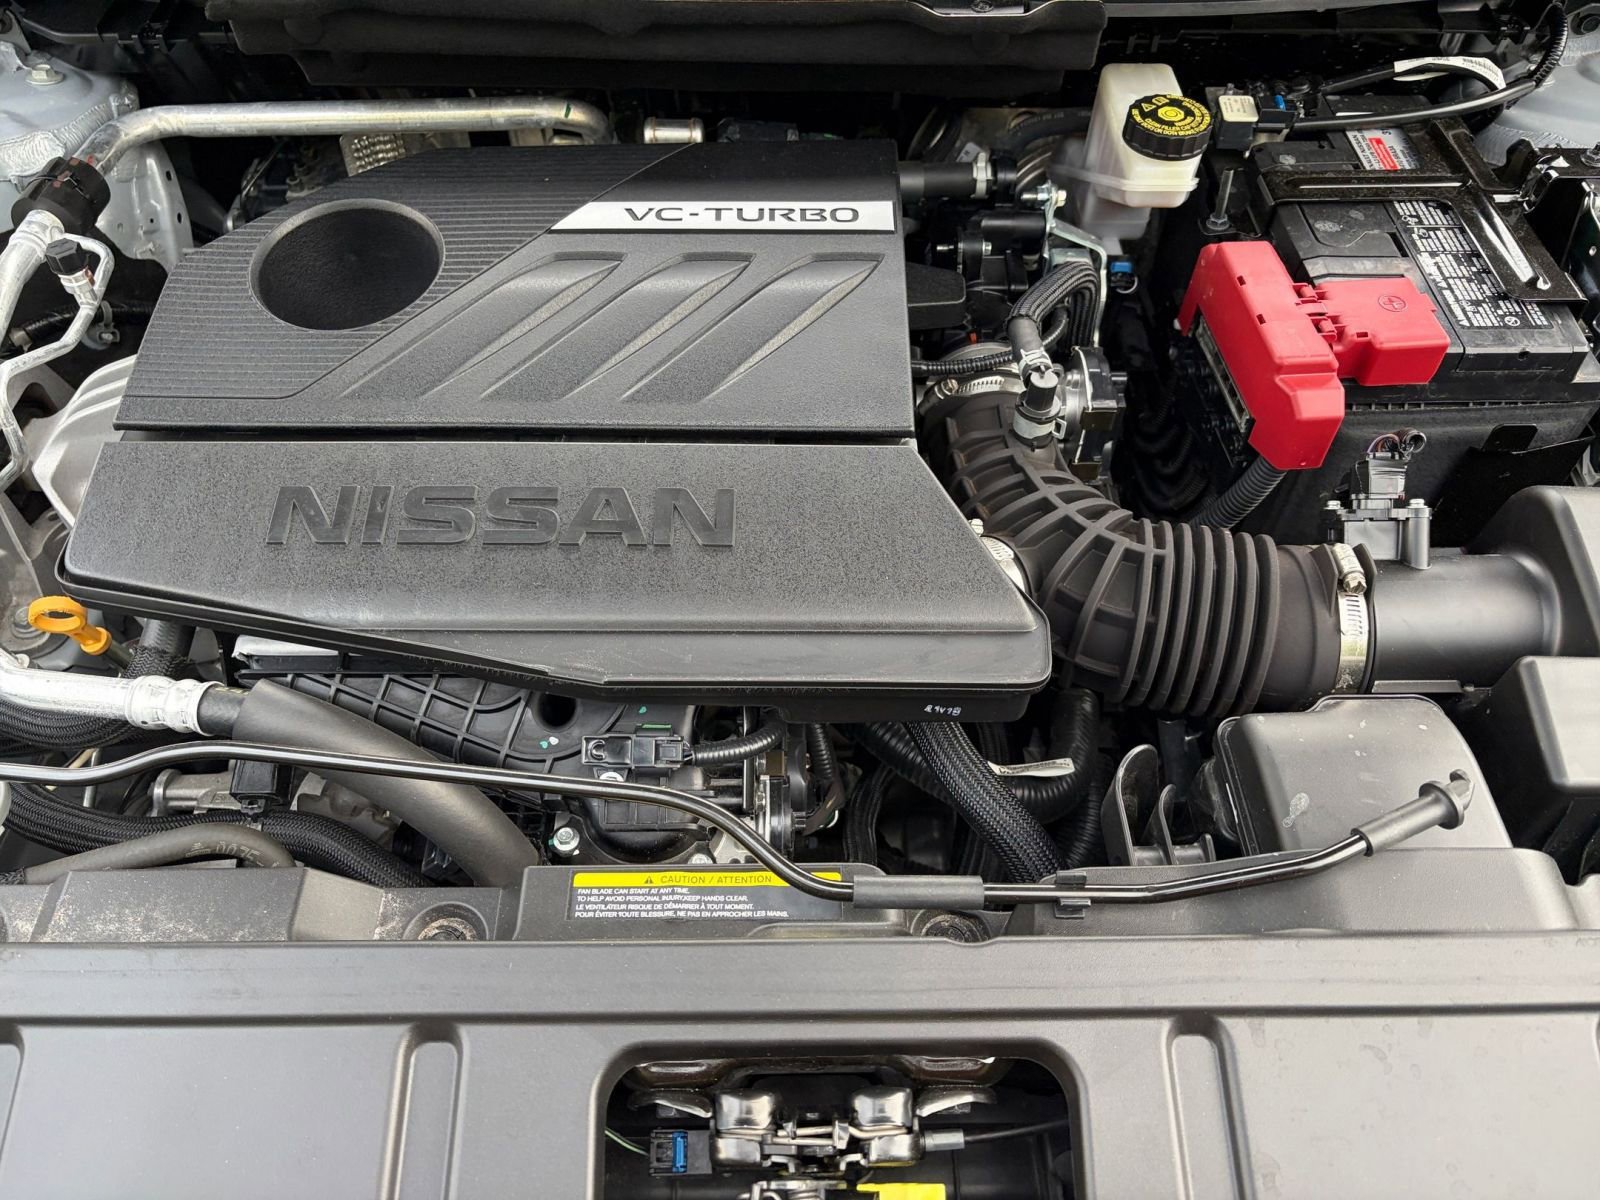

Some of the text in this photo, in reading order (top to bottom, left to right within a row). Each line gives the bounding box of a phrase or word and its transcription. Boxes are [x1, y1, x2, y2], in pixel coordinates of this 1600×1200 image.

[624, 207, 859, 223] VC-TURBO
[266, 485, 736, 547] NISSAN
[660, 875, 706, 884] CAUTION
[717, 875, 772, 884] ATTENTION
[664, 901, 699, 910] DÉMARRER
[595, 910, 617, 918] ÉVITER
